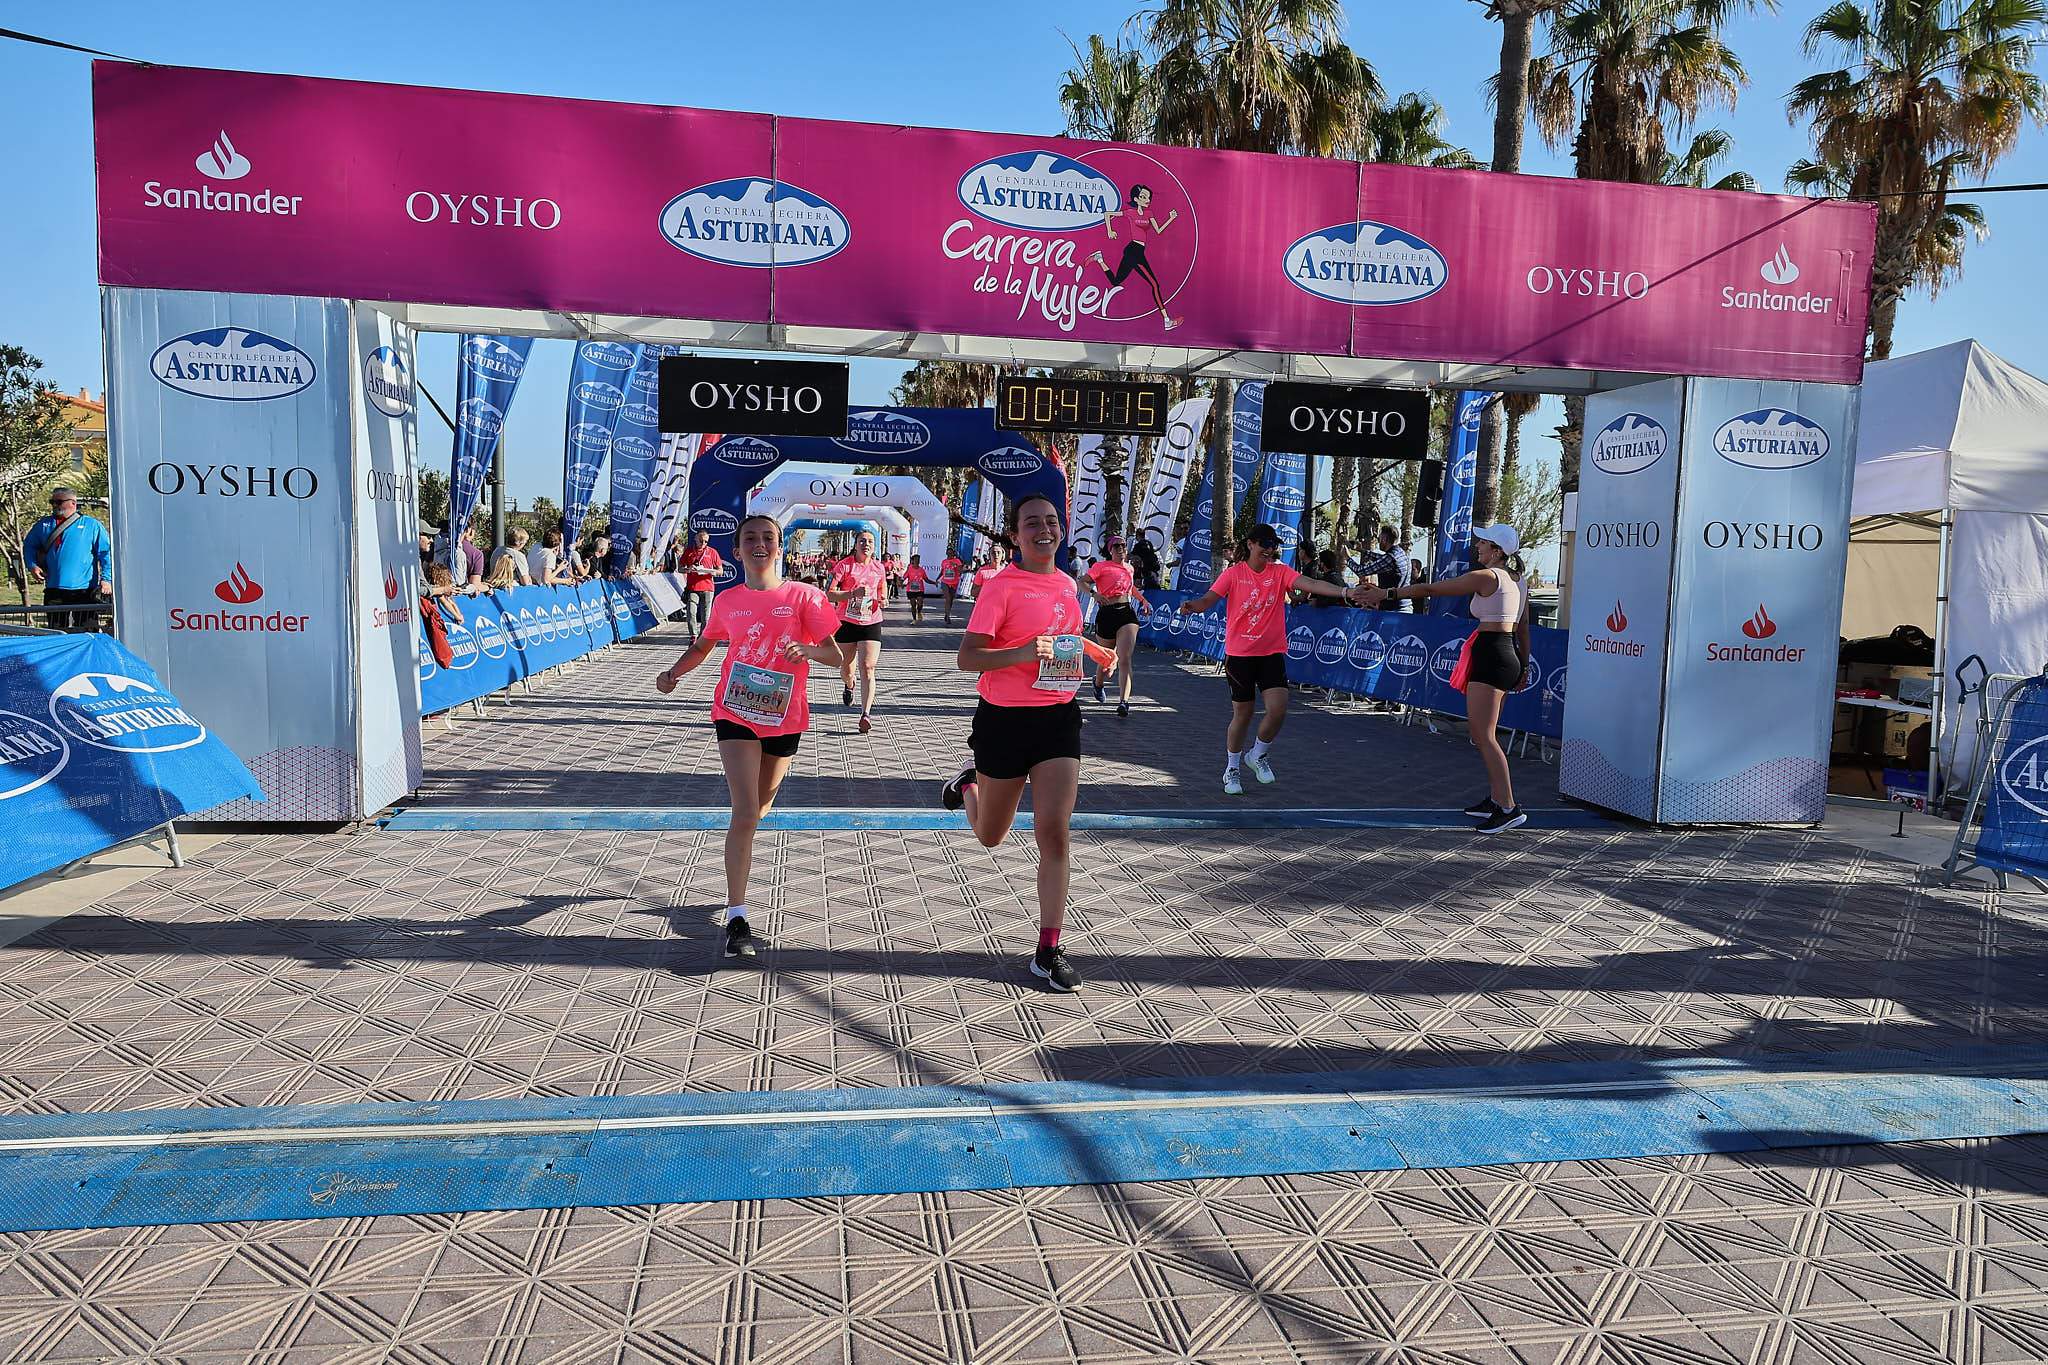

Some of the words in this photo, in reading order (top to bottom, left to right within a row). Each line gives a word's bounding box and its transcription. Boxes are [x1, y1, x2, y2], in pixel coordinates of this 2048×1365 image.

[970, 175, 1108, 213] ASTURIANA
[996, 176, 1048, 187] CENTRAL
[1053, 180, 1104, 190] LECHERA
[144, 181, 302, 216] Santander
[406, 191, 561, 230] OYSHO
[704, 205, 764, 217] CENTRAL
[674, 206, 835, 247] ASTURIANA
[942, 219, 1077, 268] Carrera
[1322, 248, 1374, 259] CENTRAL
[1379, 251, 1431, 262] LECHERA
[973, 265, 998, 293] de
[1005, 265, 1021, 294] la
[1296, 248, 1435, 286] ASTURIANA
[1526, 265, 1649, 300] OYSHO
[1017, 264, 1124, 331] Mujer
[1721, 285, 1832, 314] Santander
[163, 351, 304, 385] ASTURIANA
[188, 350, 241, 361] CENTRAL
[246, 353, 298, 363] LECHERA
[690, 381, 822, 414] OYSHO
[1290, 406, 1407, 437] OYSHO
[718, 446, 774, 461] ASTURIANA
[1596, 438, 1660, 462] ASTURIANA
[1721, 430, 1821, 456] ASTURIANA
[984, 458, 1038, 469] ASTURIANA
[148, 462, 318, 499] OYSHO
[366, 468, 413, 504] OYSHO
[809, 479, 889, 498] OYSHO
[692, 518, 735, 530] ASTURIANA
[1586, 521, 1660, 548] OYSHO
[1703, 521, 1823, 550] OYSHO
[170, 608, 309, 632] Santander
[373, 607, 412, 628] Santander
[1388, 648, 1423, 667] ASTURIANA
[1585, 634, 1645, 657] Santander
[1707, 642, 1805, 662] Santander
